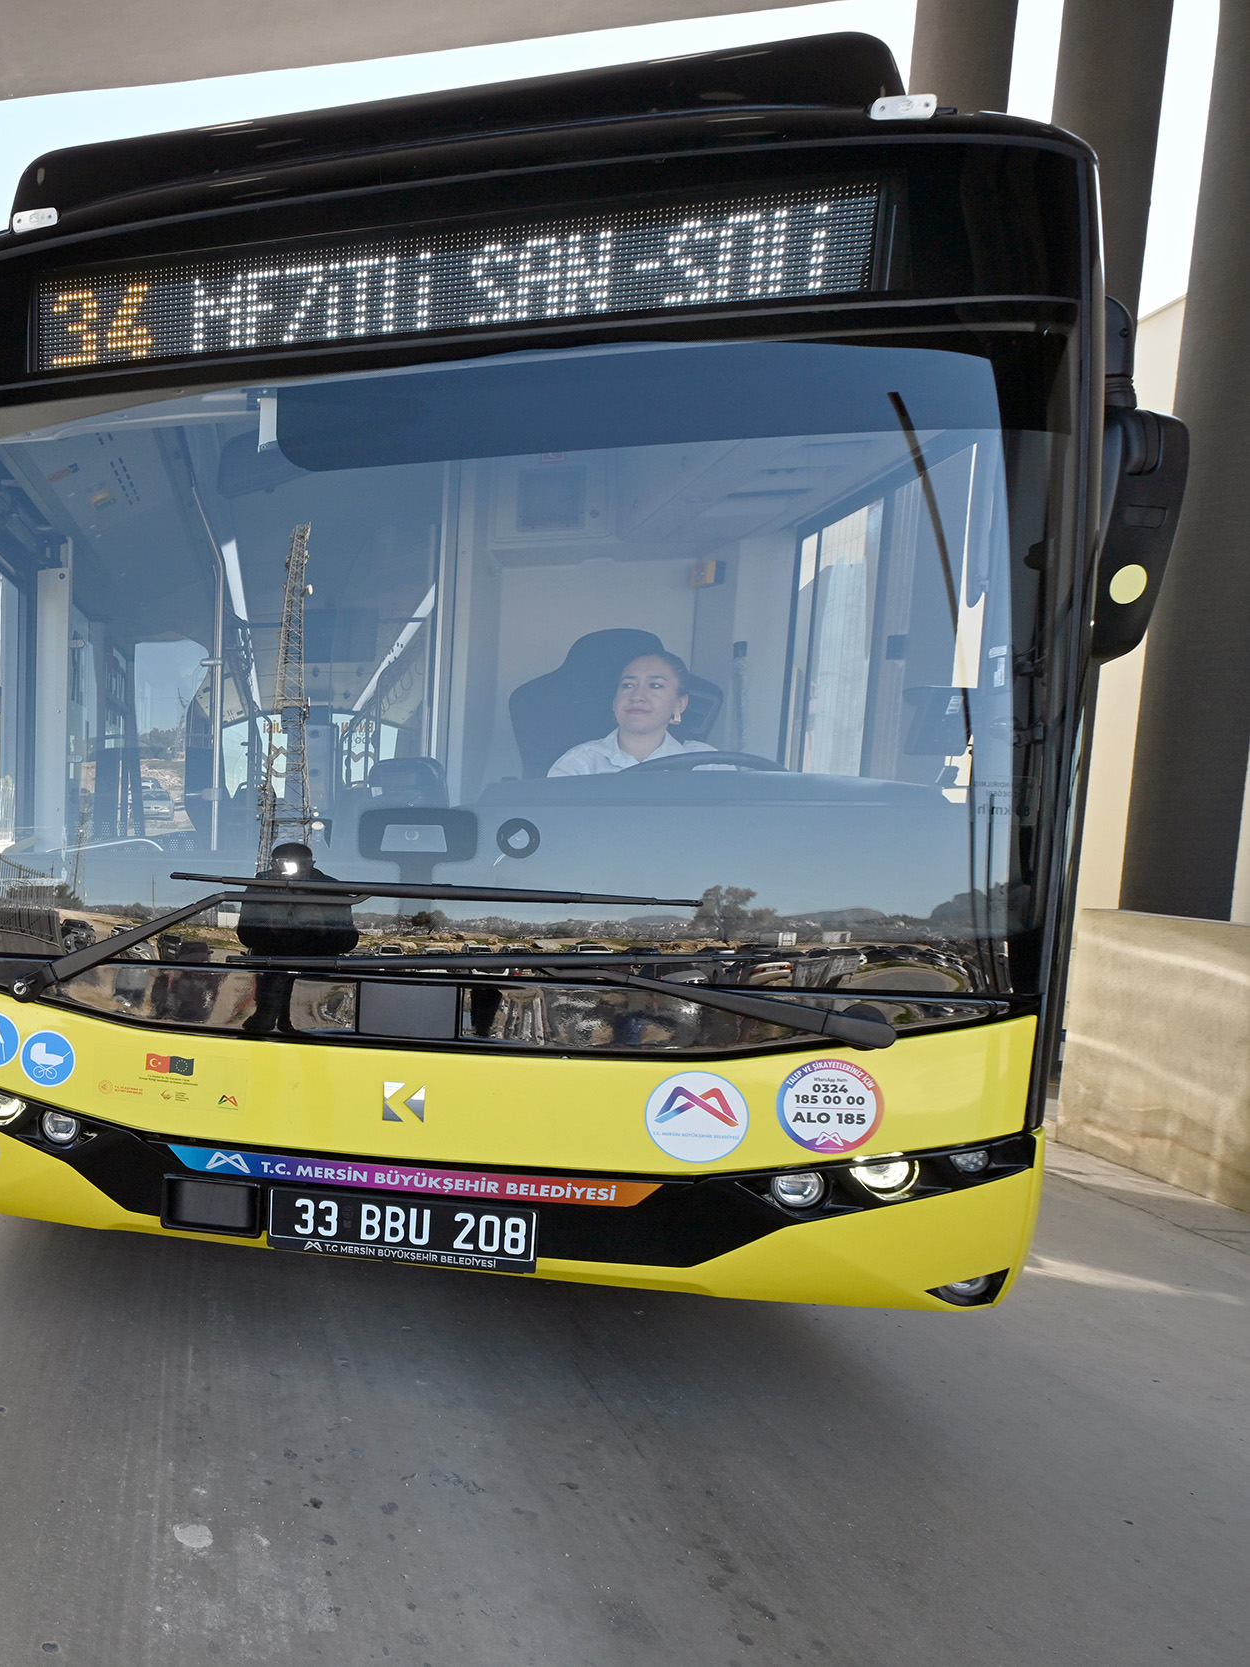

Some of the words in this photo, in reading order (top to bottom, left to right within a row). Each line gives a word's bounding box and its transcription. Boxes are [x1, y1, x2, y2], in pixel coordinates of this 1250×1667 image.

[53, 284, 151, 365] 34
[786, 1070, 802, 1086] TALEP
[802, 1064, 813, 1074] VE
[812, 1061, 864, 1078] ŞİKAYETLERİNİZ
[861, 1074, 875, 1089] İÇİN
[794, 1094, 818, 1104] 185
[823, 1095, 842, 1105] 00
[846, 1096, 865, 1105] 00
[812, 1083, 848, 1093] 0324
[792, 1111, 831, 1124] ALO
[836, 1113, 866, 1125] 185
[261, 1161, 291, 1176] T.C.
[295, 1165, 368, 1183] MERSİN
[374, 1169, 499, 1193] BÜYÜKŞEHİR
[505, 1182, 617, 1202] BELEDİYESİ
[294, 1198, 338, 1237] 33
[360, 1204, 431, 1246] BBU
[453, 1212, 527, 1255] 208
[340, 1245, 375, 1256] MERSİN
[377, 1248, 438, 1262] BÜYÜKŞEHİR
[440, 1254, 496, 1268] BELEDİYESİ
